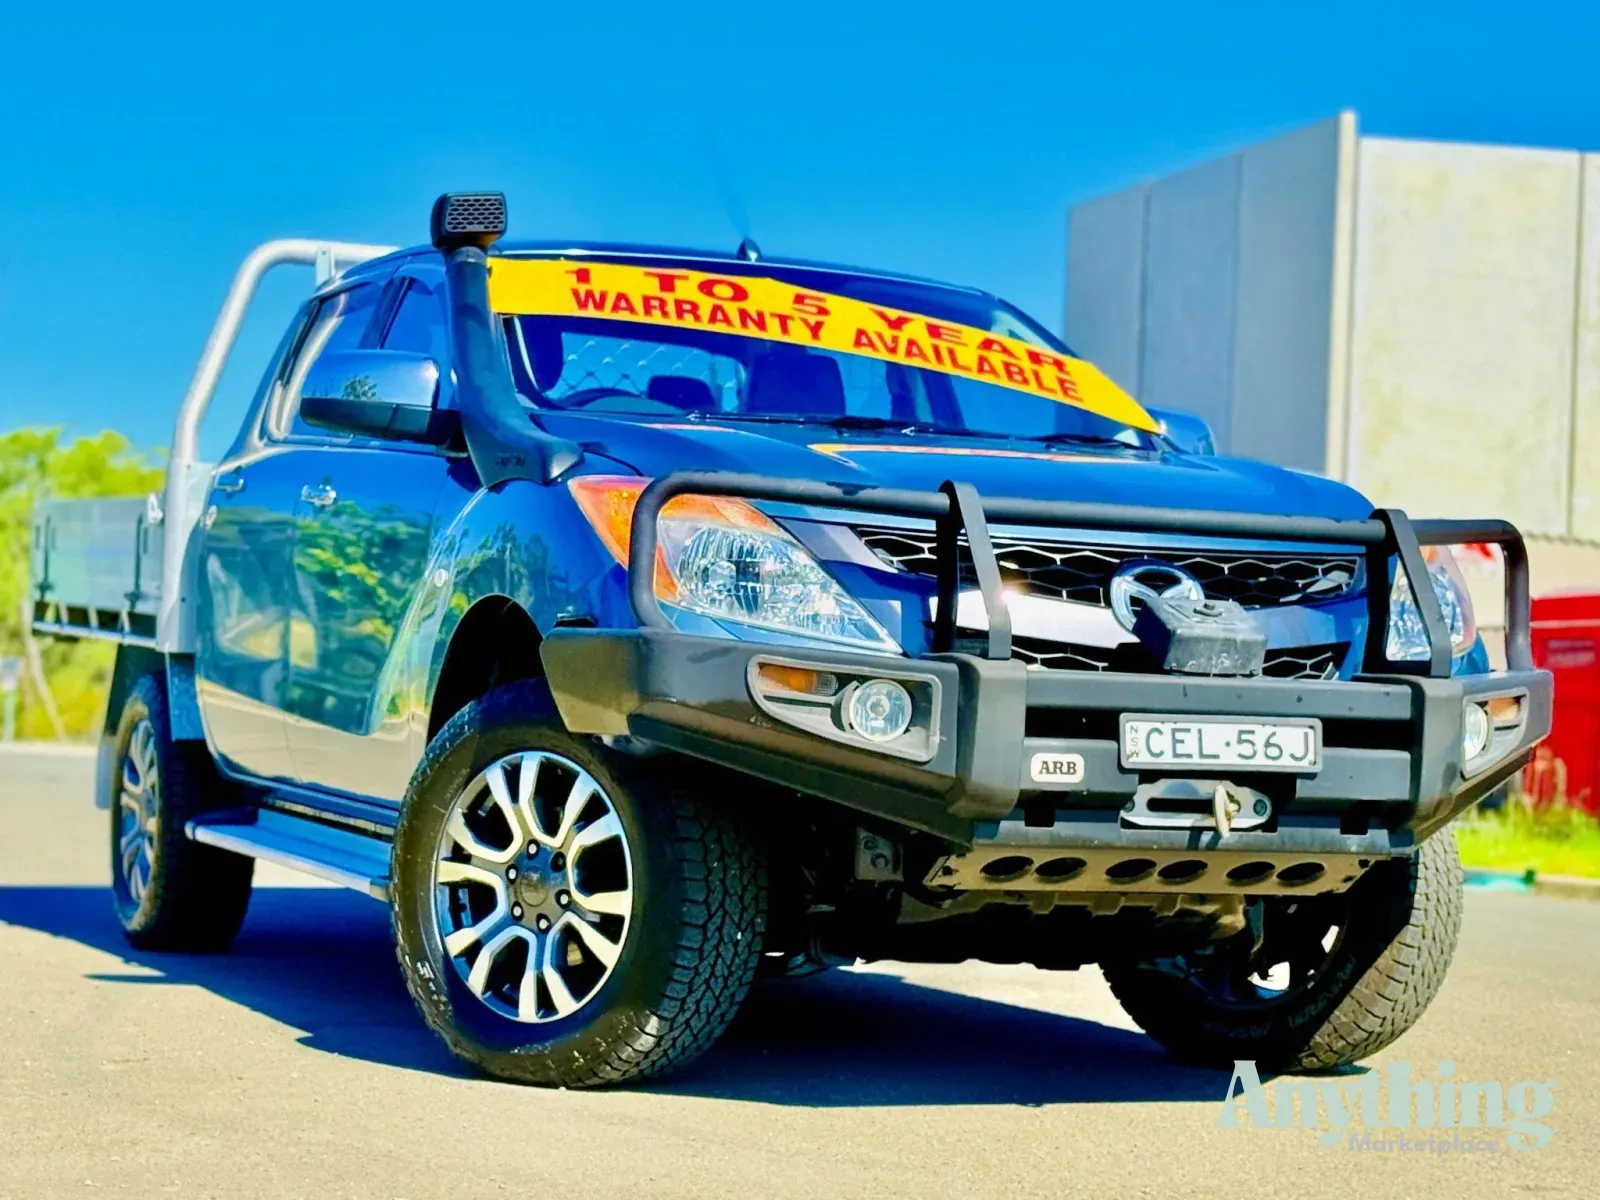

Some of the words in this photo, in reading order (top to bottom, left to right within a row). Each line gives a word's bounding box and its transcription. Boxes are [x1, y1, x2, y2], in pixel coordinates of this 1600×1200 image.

[565, 268, 591, 284] 1
[643, 271, 749, 302] TO
[792, 293, 831, 317] 5
[869, 307, 1071, 376] YEAR
[570, 288, 825, 341] WARRANTY
[852, 328, 1083, 402] AVAILABLE
[1038, 760, 1077, 775] ARB
